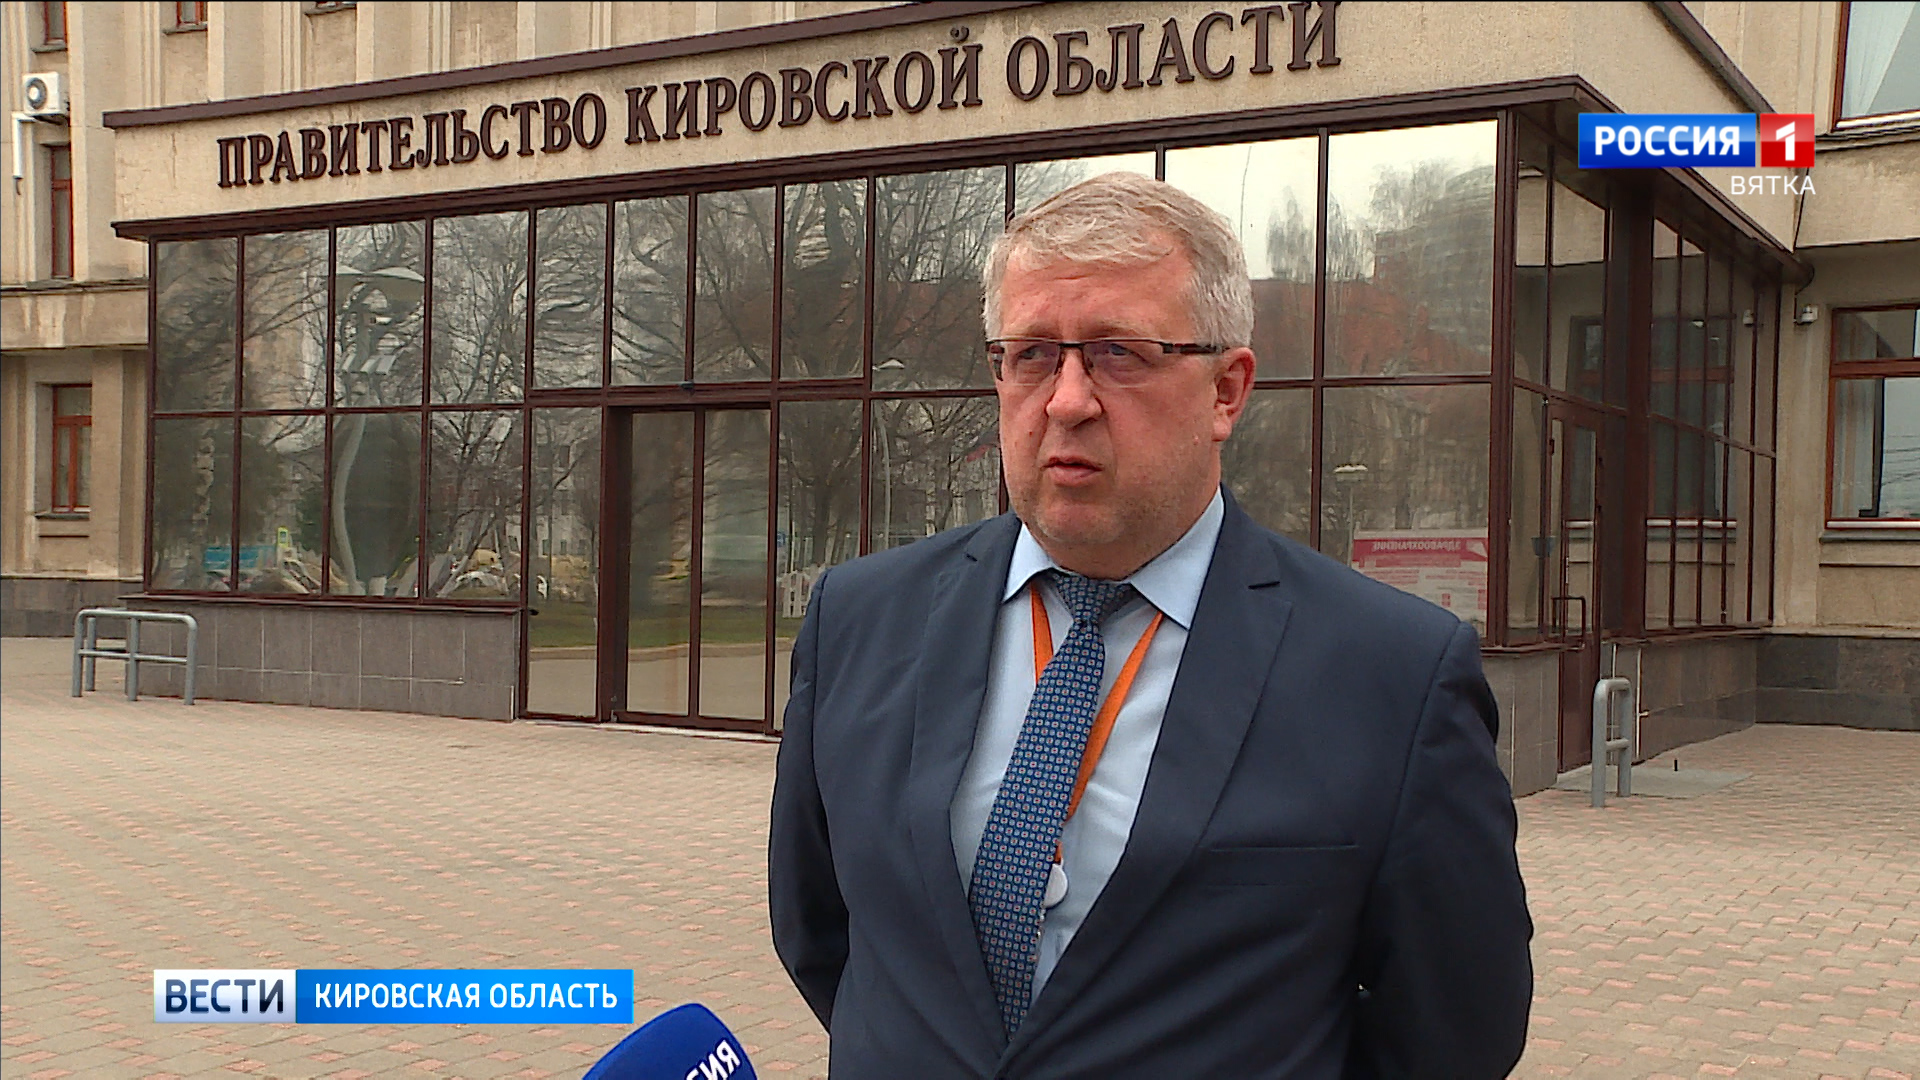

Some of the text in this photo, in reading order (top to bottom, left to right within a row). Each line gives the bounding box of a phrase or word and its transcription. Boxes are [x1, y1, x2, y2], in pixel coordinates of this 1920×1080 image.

[217, 1, 1341, 188] ПРАВИТЕЛЬСТВО КИРОВСКОЙ ОБЛАСТИ
